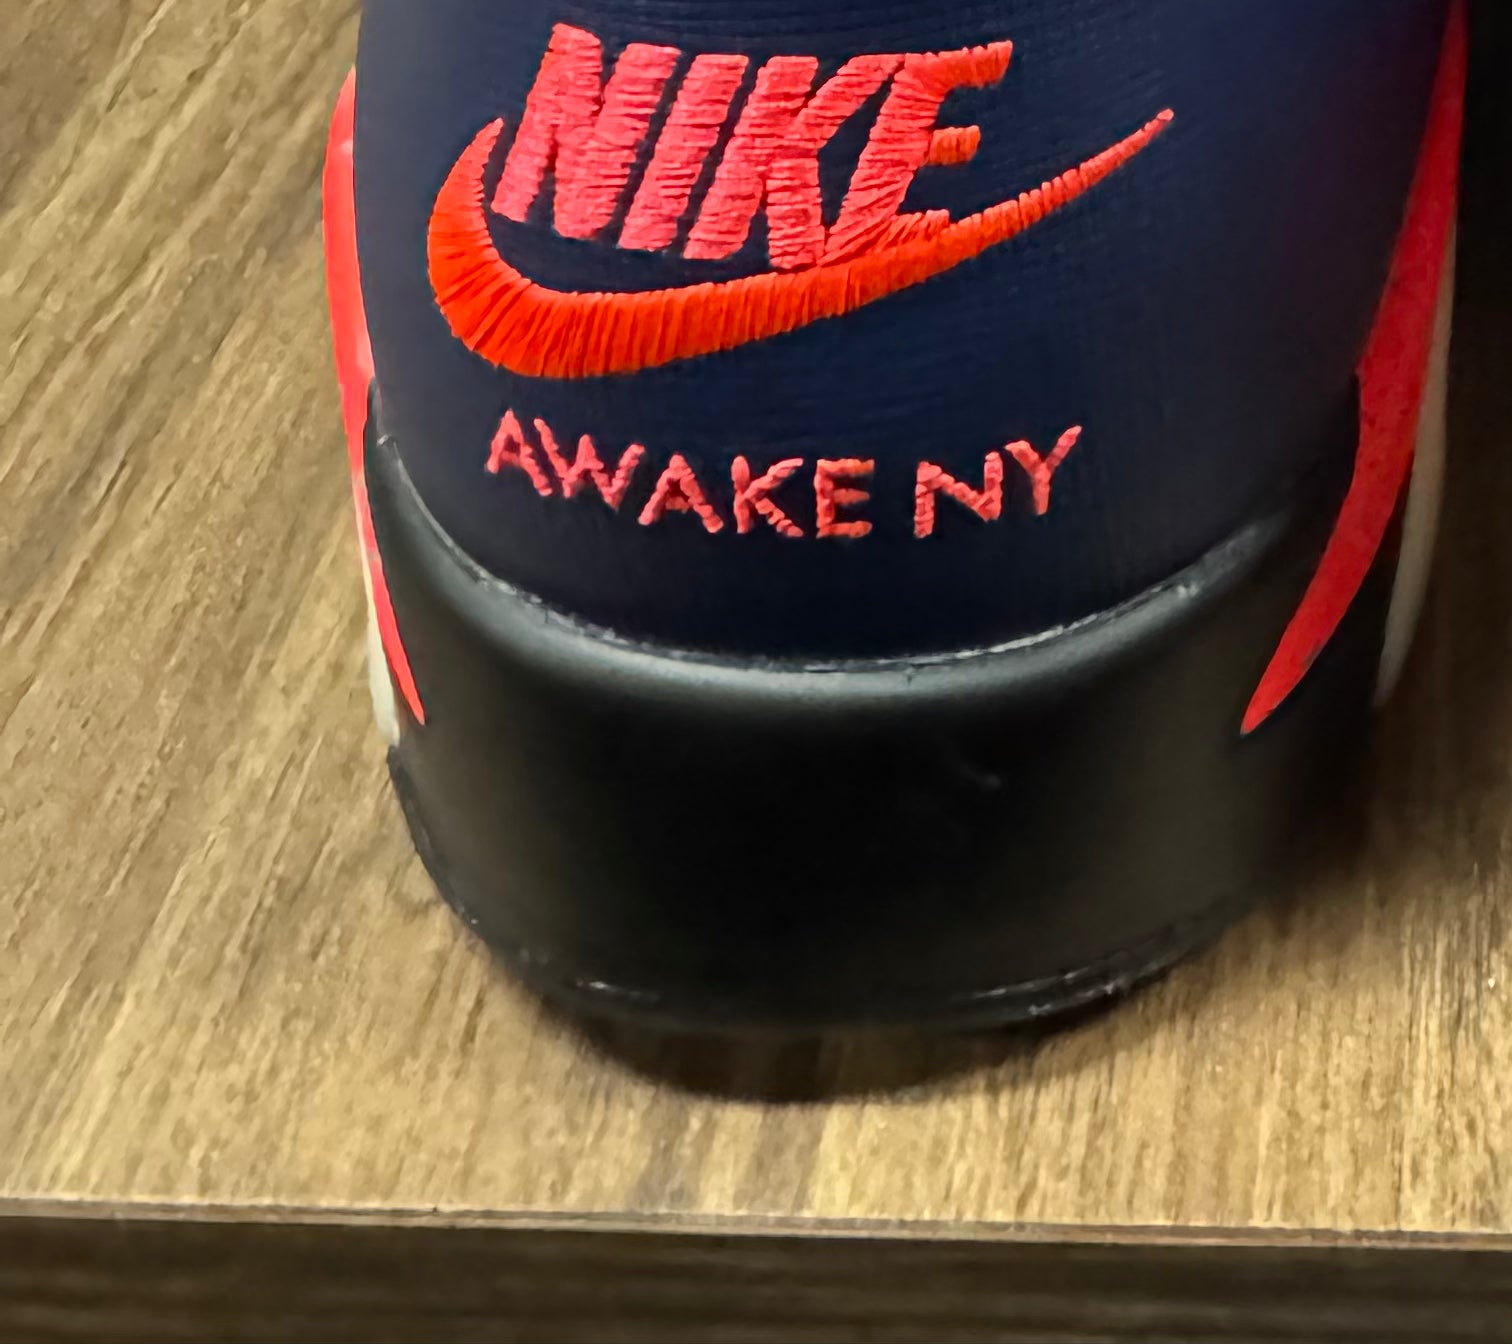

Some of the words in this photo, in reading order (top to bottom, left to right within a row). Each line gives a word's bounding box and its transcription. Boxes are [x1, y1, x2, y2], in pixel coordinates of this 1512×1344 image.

[489, 22, 1014, 269] NIKE
[486, 409, 875, 538] AWAKE
[914, 425, 1082, 537] NY
